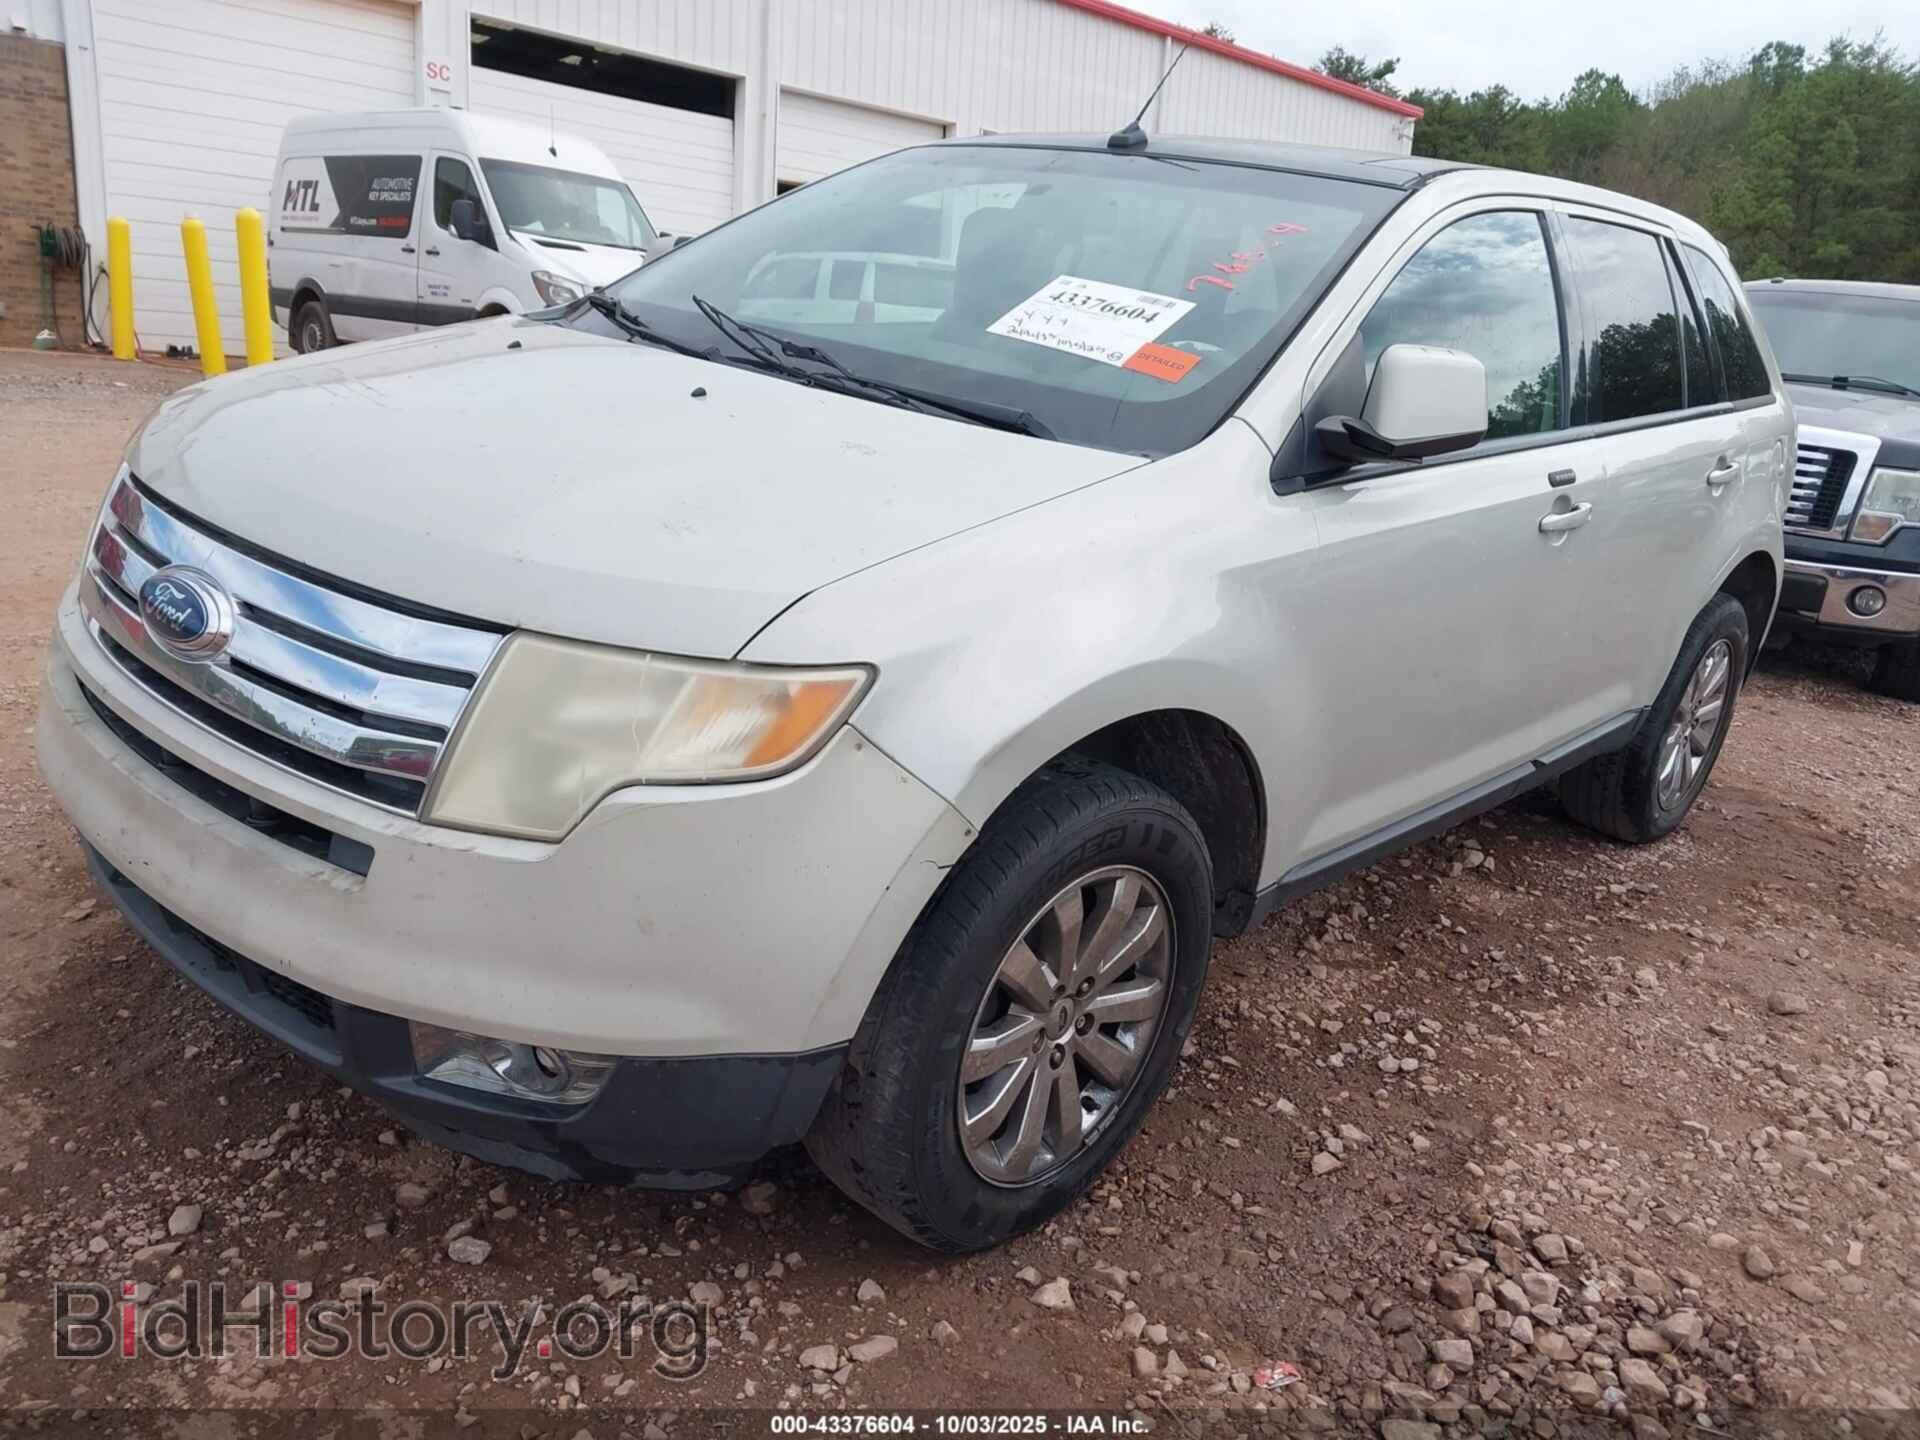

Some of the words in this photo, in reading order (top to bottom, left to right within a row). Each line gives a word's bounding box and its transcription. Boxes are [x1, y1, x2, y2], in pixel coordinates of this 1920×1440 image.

[426, 61, 450, 81] SC
[1048, 291, 1161, 323] 43376604
[1138, 352, 1185, 371] DETAILED
[146, 582, 192, 631] Ford
